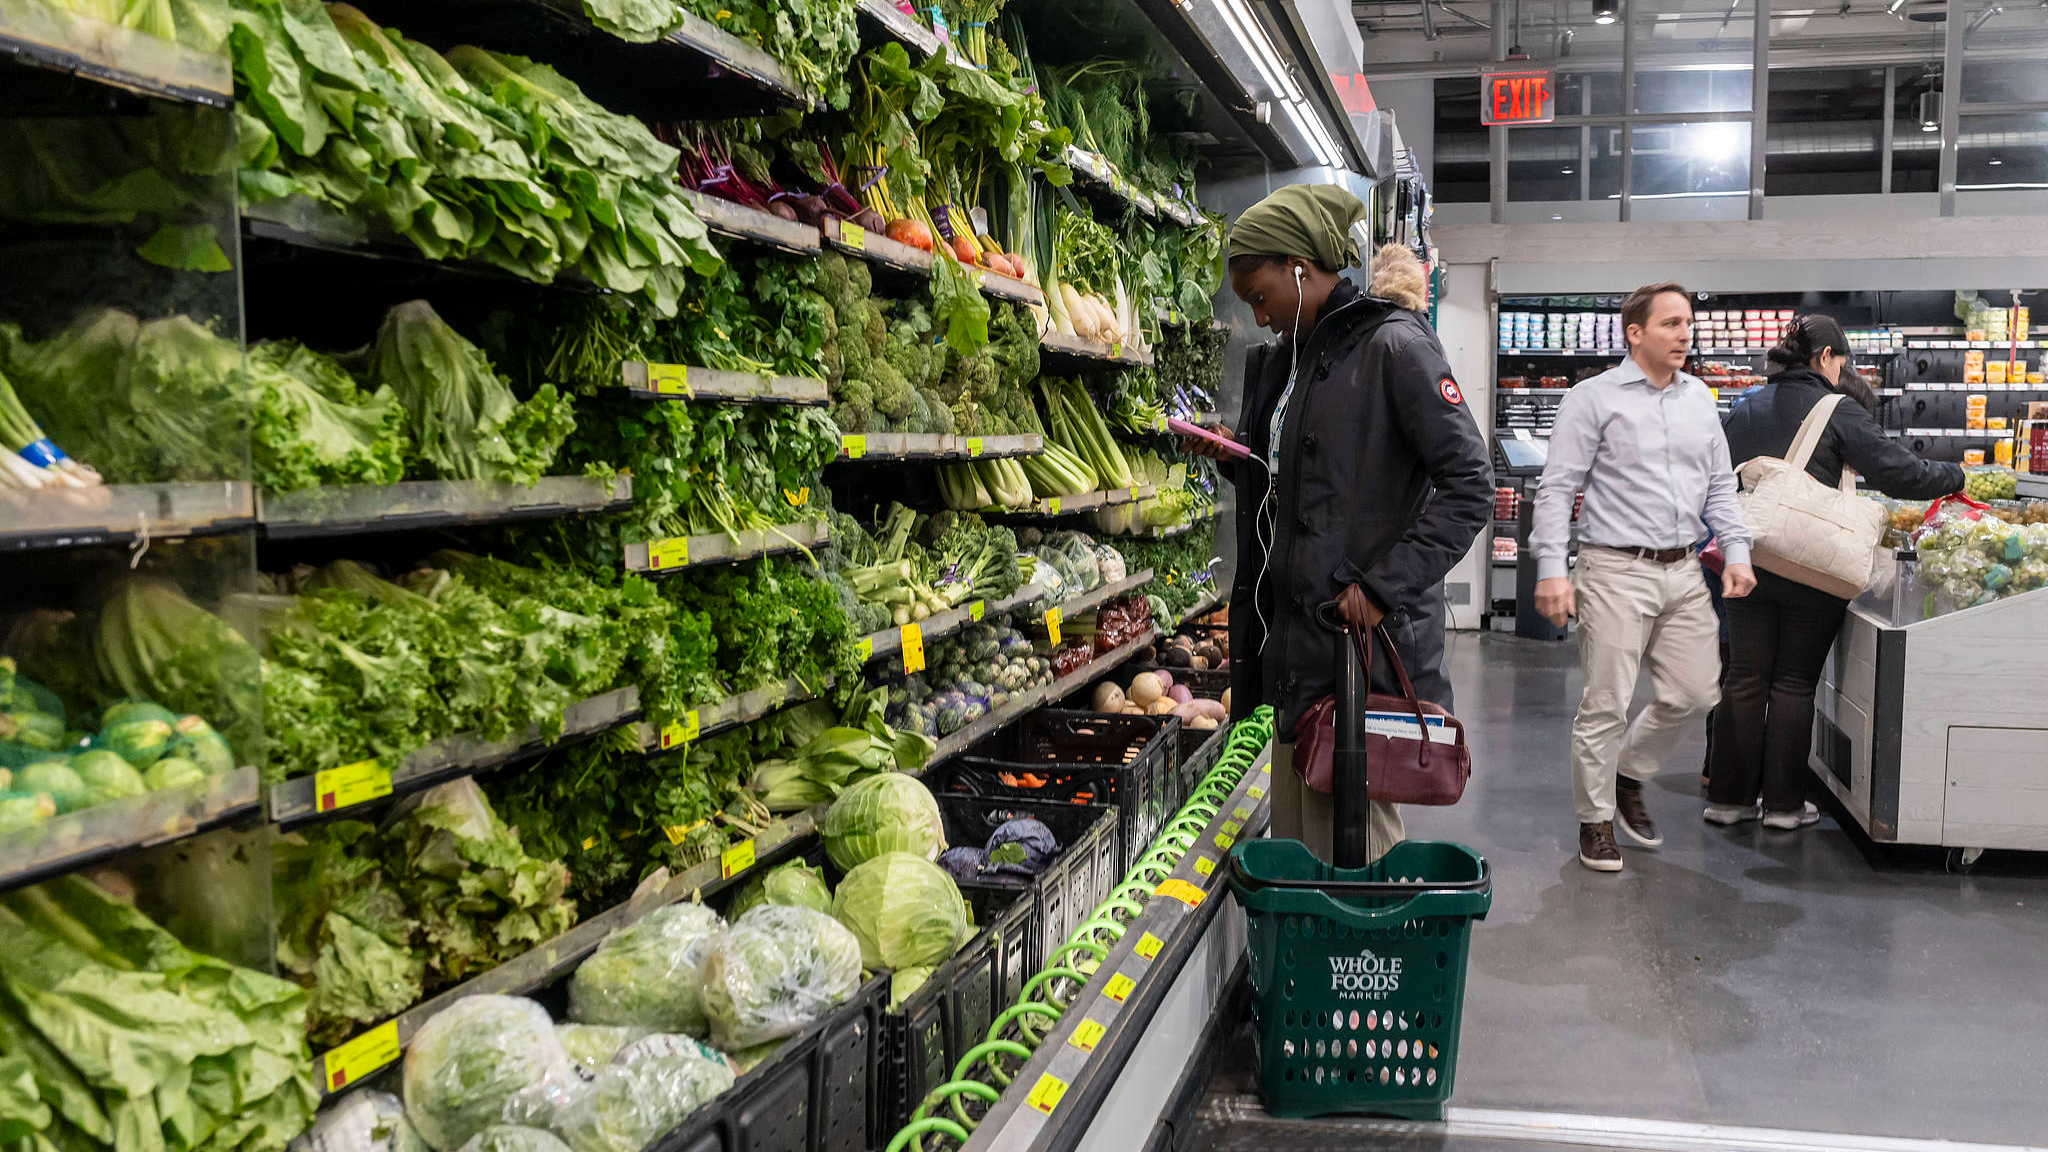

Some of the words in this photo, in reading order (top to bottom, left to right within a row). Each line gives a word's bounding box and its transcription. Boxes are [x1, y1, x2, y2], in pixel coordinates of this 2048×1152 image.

[1493, 77, 1546, 120] EXIT
[1328, 956, 1402, 974] WHOLE
[1331, 973, 1399, 991] FOODS
[1339, 991, 1389, 1000] MARKET
